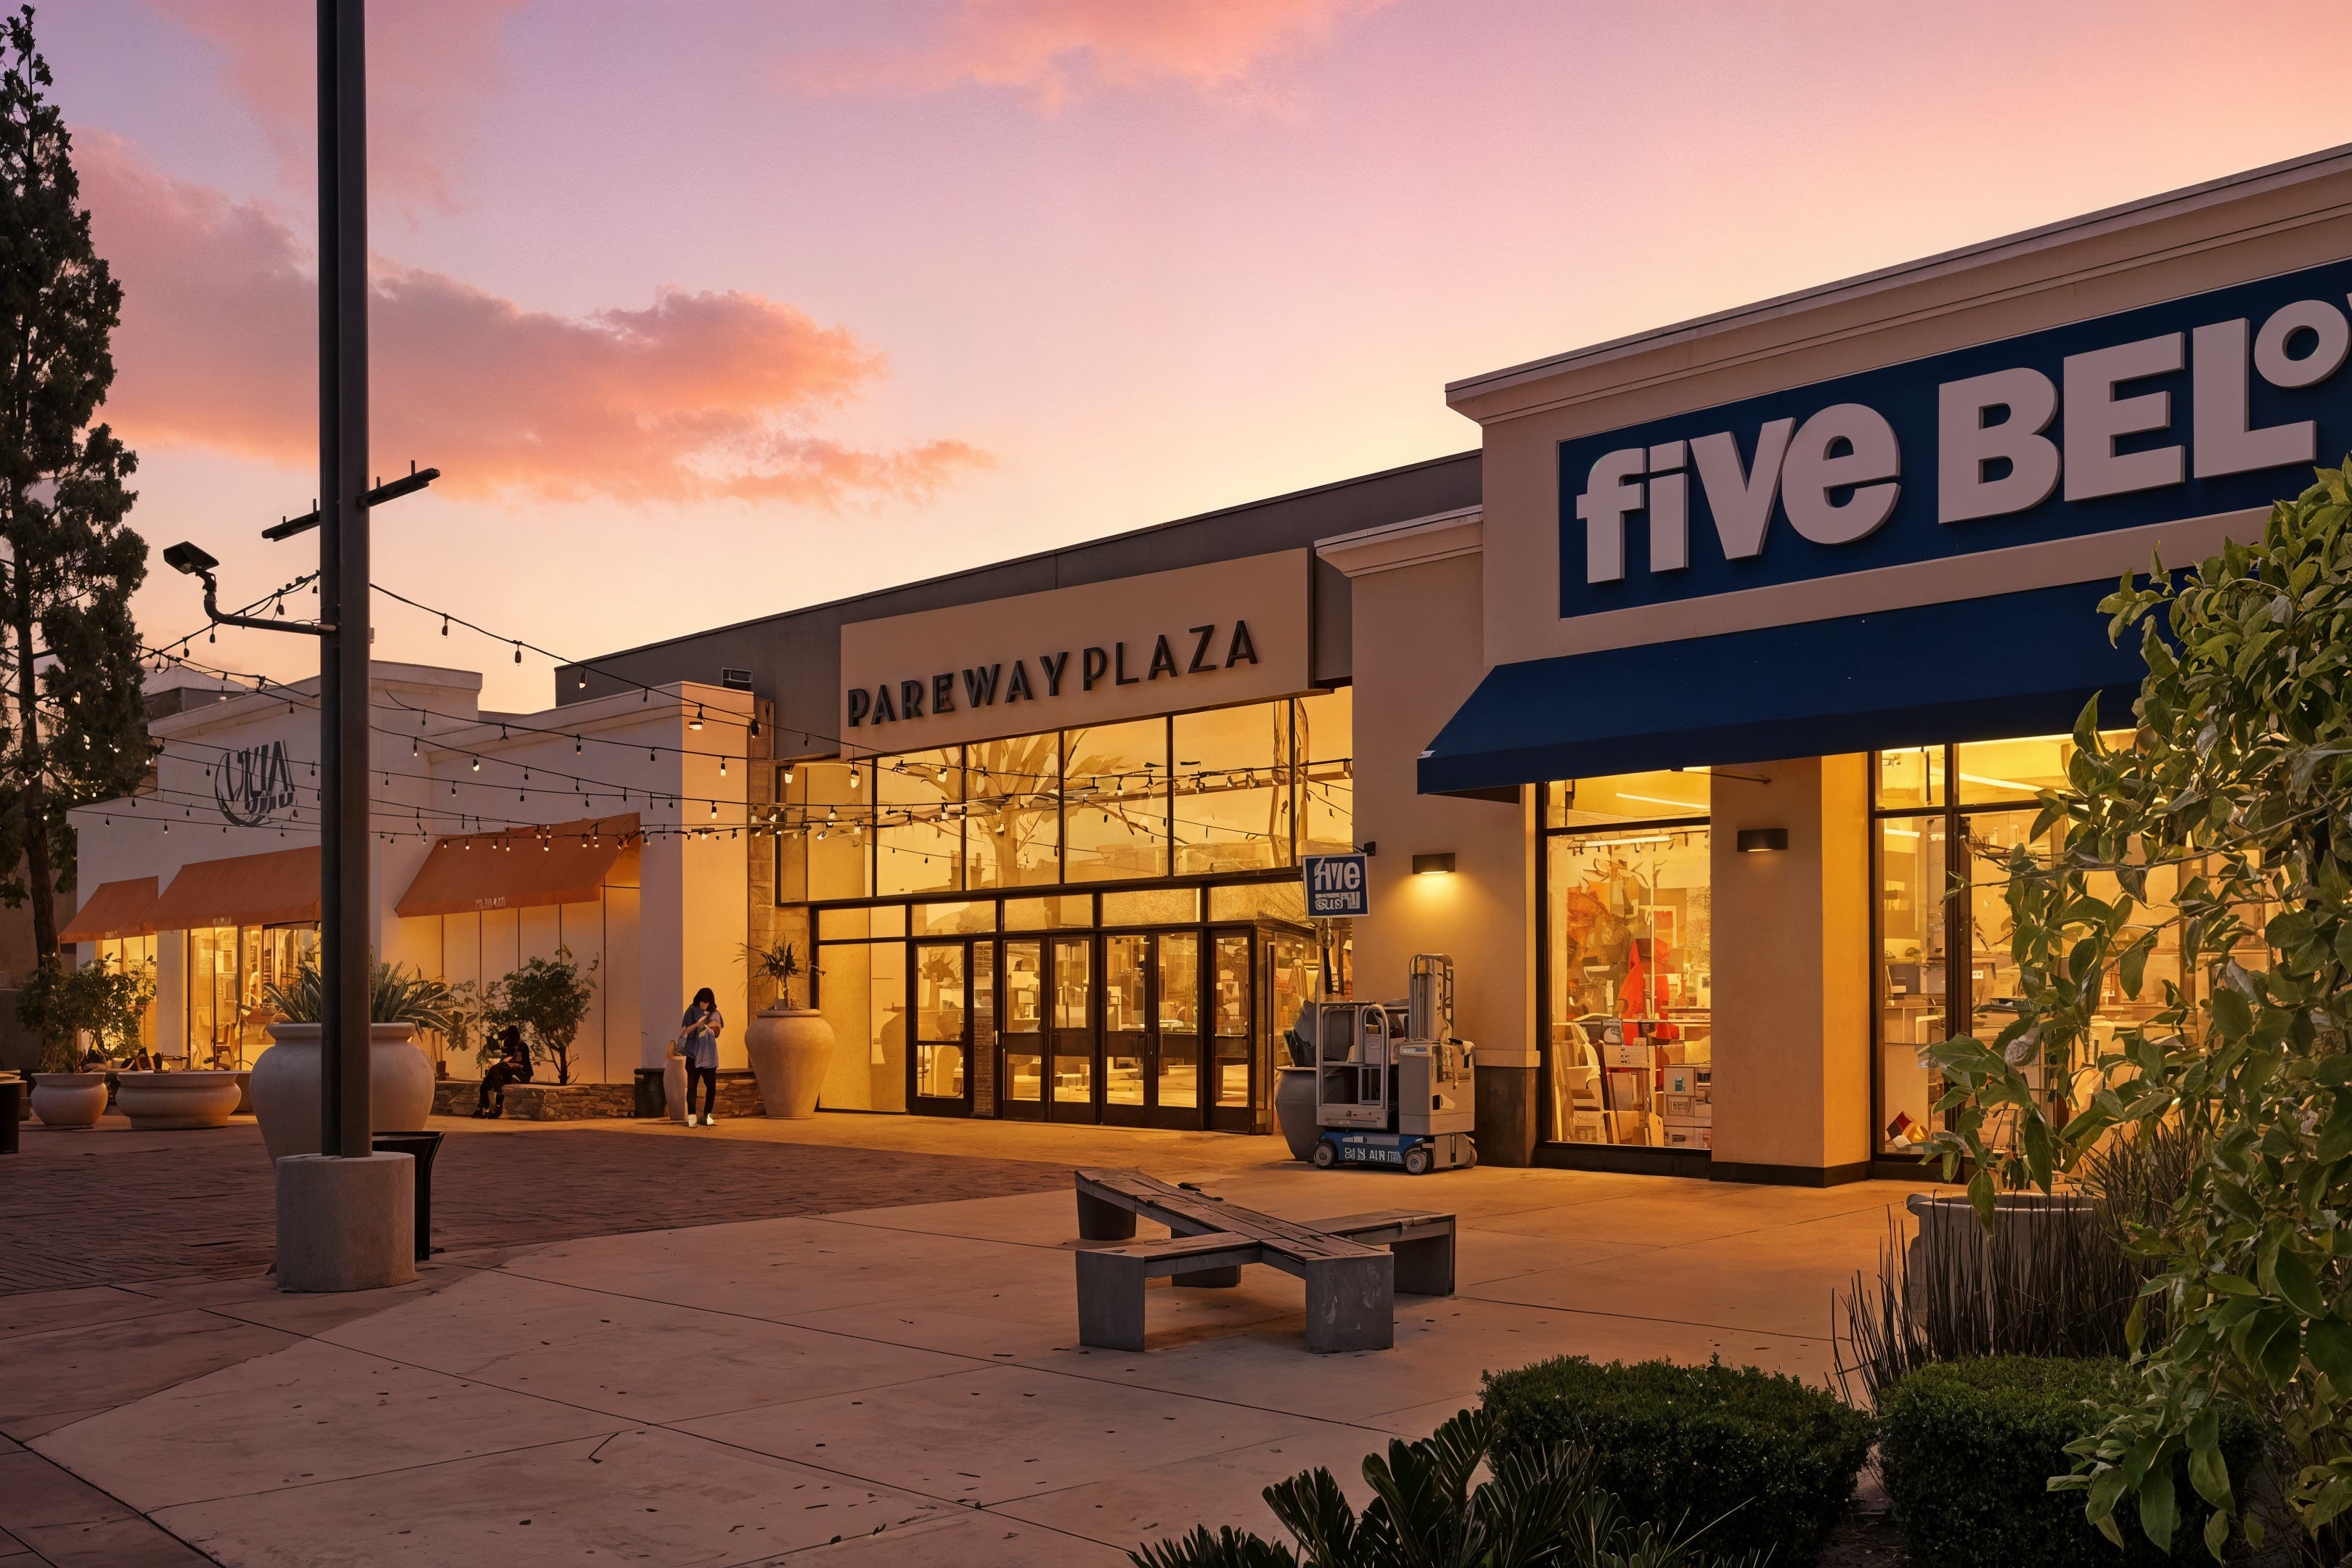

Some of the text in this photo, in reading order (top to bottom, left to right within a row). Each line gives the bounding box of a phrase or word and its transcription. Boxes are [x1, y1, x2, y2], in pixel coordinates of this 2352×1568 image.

[1576, 293, 2352, 584] five BELO
[1082, 619, 1259, 692] PLAZA
